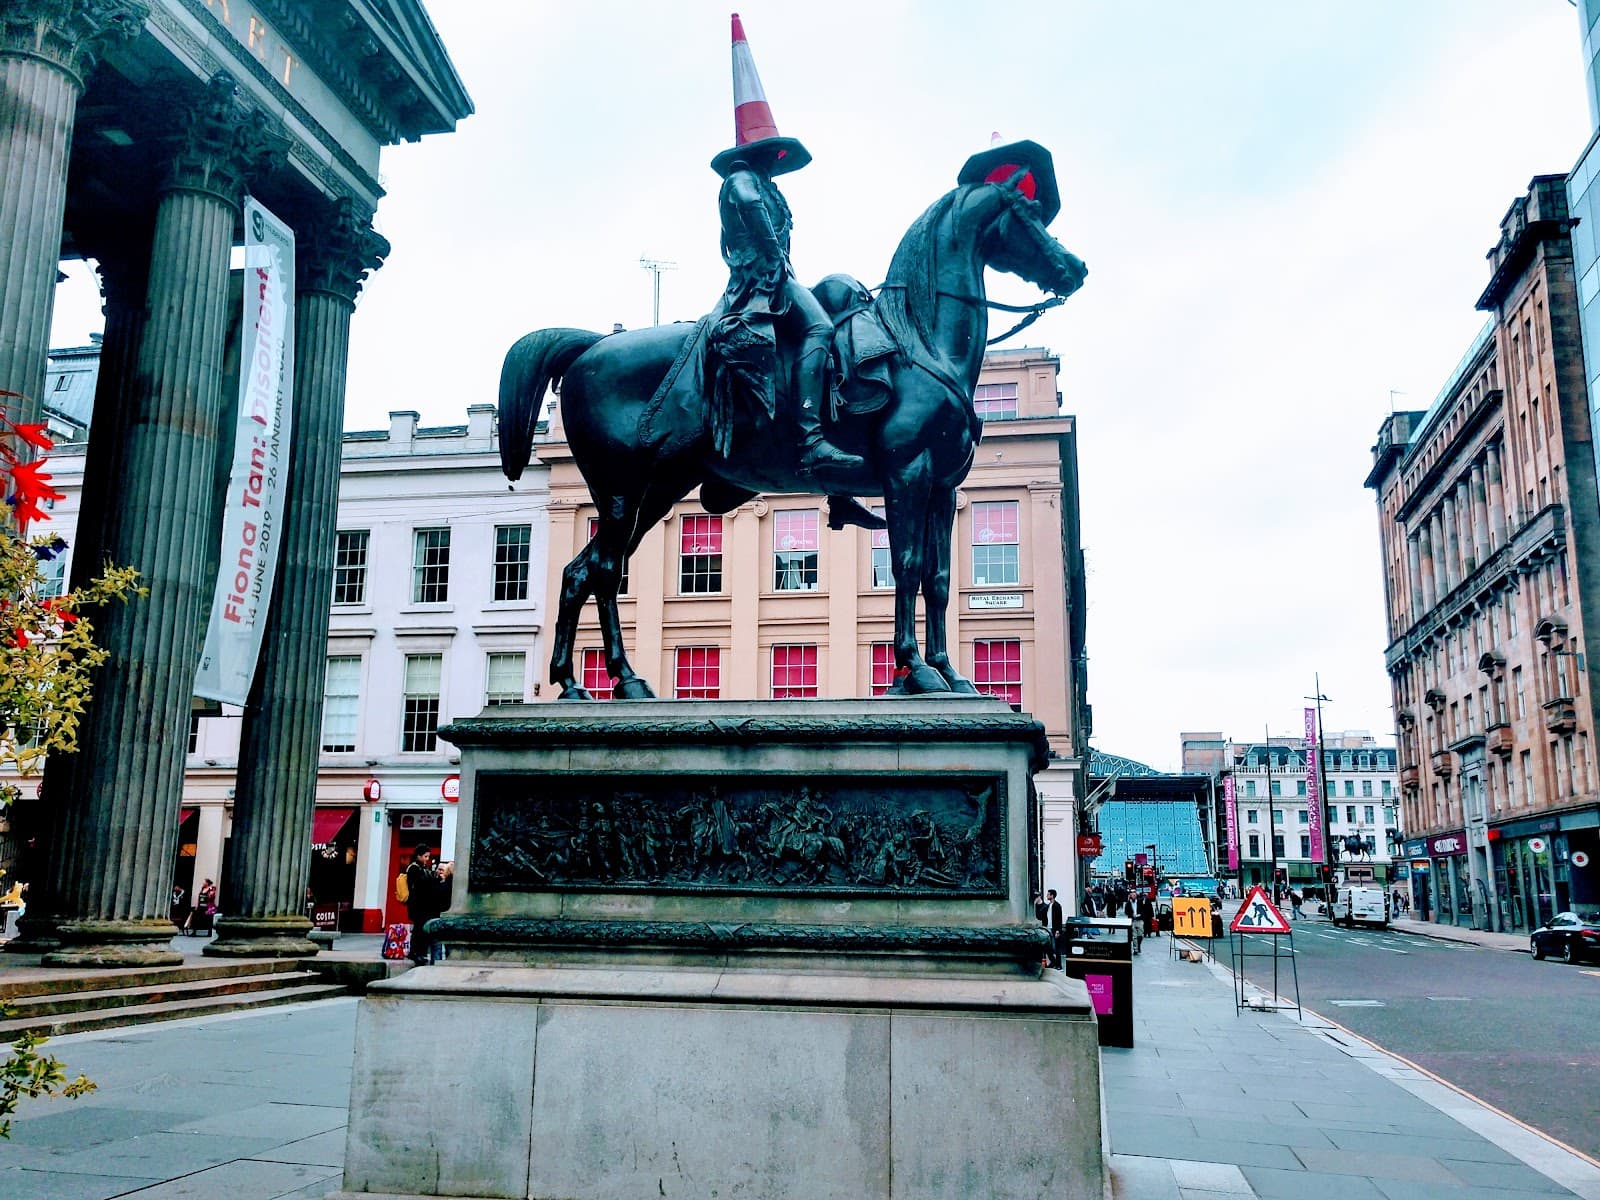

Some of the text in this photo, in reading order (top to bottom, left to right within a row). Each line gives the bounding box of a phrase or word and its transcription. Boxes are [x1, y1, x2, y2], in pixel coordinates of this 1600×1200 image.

[267, 467, 278, 490] 26
[223, 520, 257, 624] Fiona
[242, 436, 268, 509] Tan:
[259, 510, 273, 553] 2019
[254, 559, 267, 603] JUNE
[245, 607, 257, 628] 14
[1306, 750, 1315, 776] MAKE
[1225, 778, 1233, 800] PEOPLE
[1306, 779, 1318, 831] GLASGOW
[311, 843, 327, 851] OSTA
[1227, 820, 1236, 851] GLASGOW
[316, 911, 335, 921] COSTA
